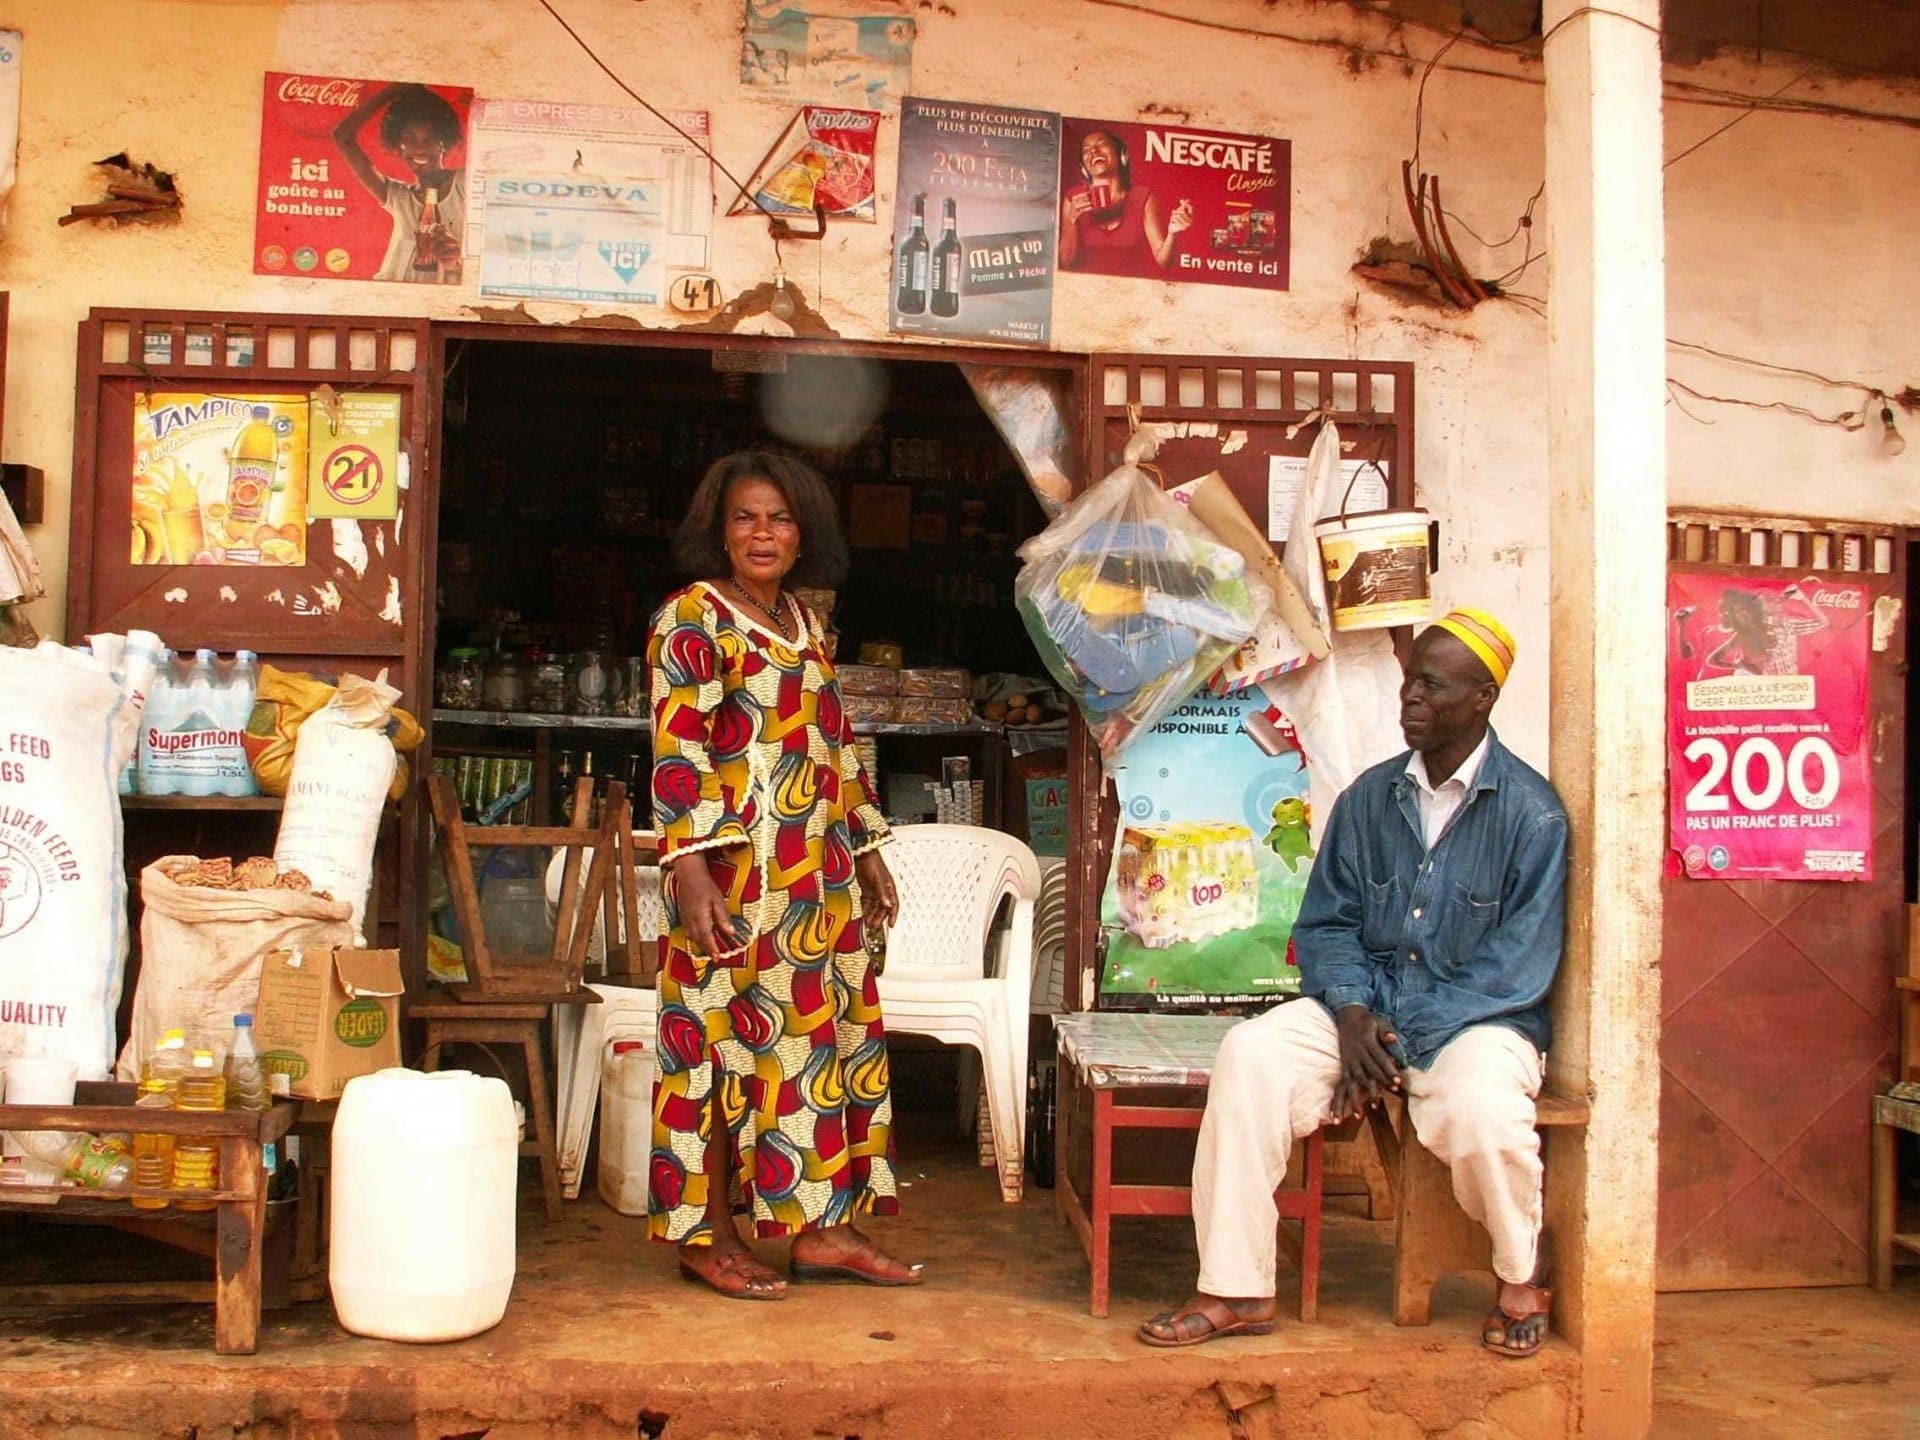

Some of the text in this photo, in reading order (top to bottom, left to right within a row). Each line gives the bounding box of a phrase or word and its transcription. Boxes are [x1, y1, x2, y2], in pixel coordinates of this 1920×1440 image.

[279, 76, 362, 107] Coca-Cola
[513, 102, 600, 122] EXPRESS
[608, 107, 707, 129] EXCNGE
[918, 107, 946, 118] PLUS
[950, 110, 967, 120] DE
[937, 121, 965, 132] PLUS
[933, 151, 975, 176] 200
[1145, 131, 1273, 174] NESCAFÉ
[290, 158, 329, 182] ici
[268, 184, 345, 200] goûte au
[499, 180, 649, 202] SODEVA
[1227, 174, 1278, 192] Classic
[266, 200, 346, 217] bonheur
[611, 251, 641, 269] ICI
[968, 240, 1042, 268] Malt up
[1180, 254, 1278, 275] En vente ici
[971, 271, 1005, 283] Pomme
[1019, 267, 1047, 278] Pêche
[684, 279, 714, 309] 41
[149, 400, 253, 440] TAMPICO
[333, 456, 369, 489] 21
[1813, 589, 1863, 609] Coca-Cola
[1751, 684, 1762, 693] LA
[1766, 683, 1780, 692] VIE
[1782, 682, 1809, 692] MOINS
[1728, 696, 1751, 706] AVEC
[149, 727, 244, 754] Supermont
[1685, 727, 1697, 735] La
[1698, 725, 1740, 735] bouteille
[1741, 725, 1764, 735] petit
[10, 733, 51, 759] FEED
[0, 761, 25, 783] GS
[1684, 737, 1840, 811] 200
[1686, 817, 1710, 830] PAS
[1711, 816, 1730, 829] UN
[1733, 815, 1776, 829] FRANC
[1779, 815, 1798, 828] DE
[1800, 814, 1834, 828] PLUS
[0, 804, 80, 881] LDEN FEEDS
[1192, 883, 1222, 906] top
[1157, 993, 1284, 1004] La qualité au meilleur prix
[1, 1000, 67, 1027] UALITY
[338, 1010, 385, 1037] LEADER
